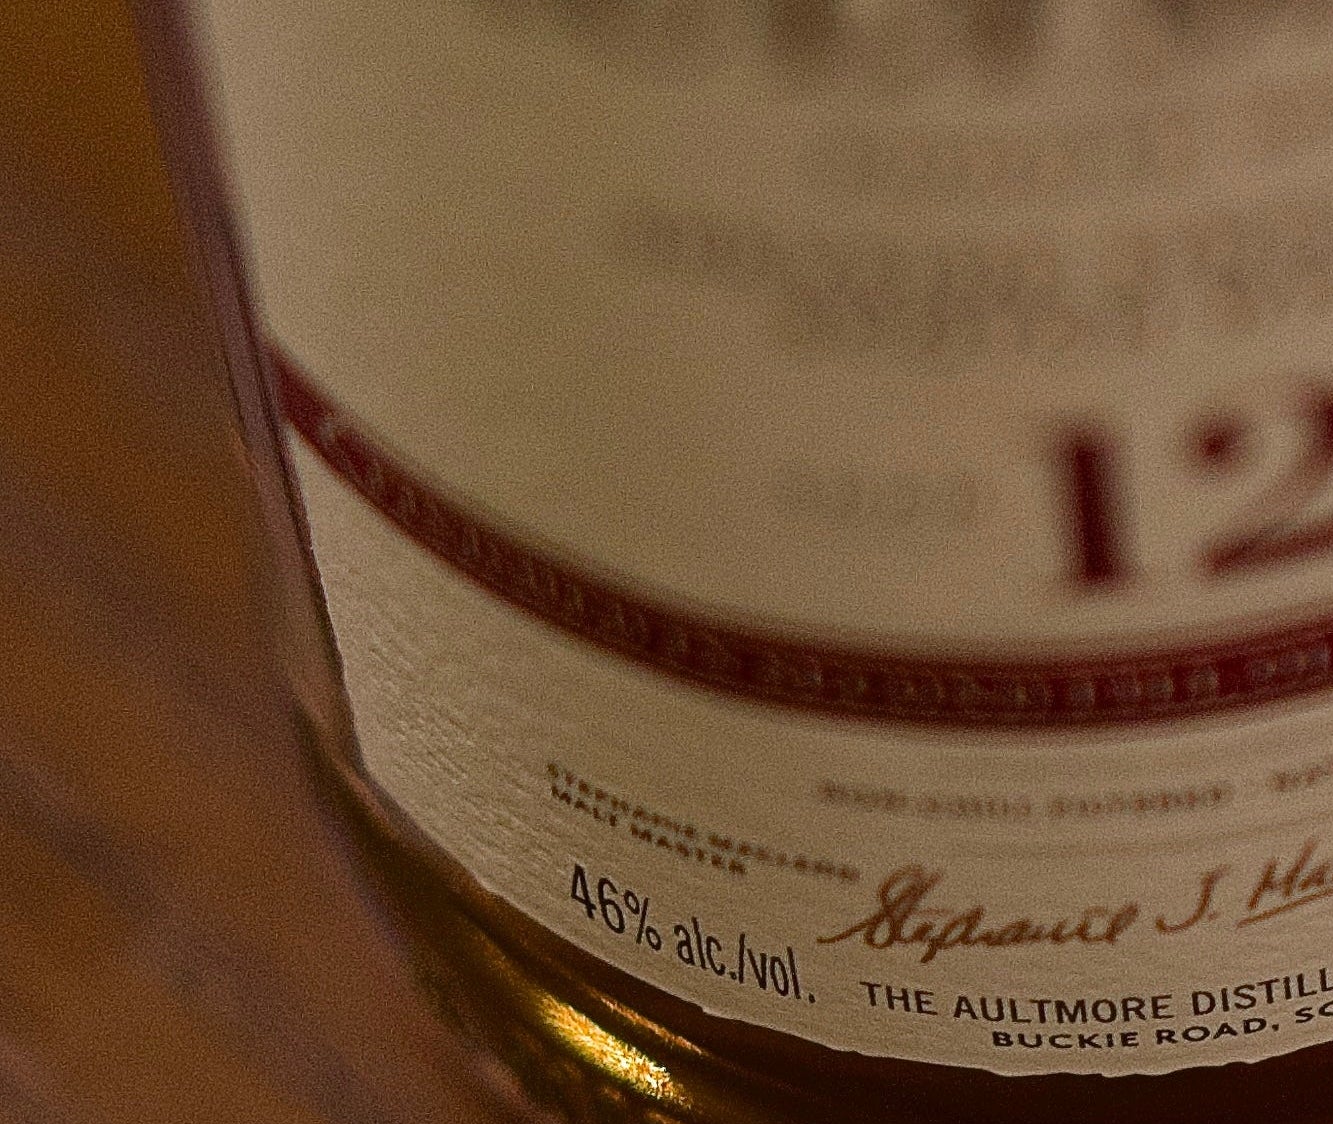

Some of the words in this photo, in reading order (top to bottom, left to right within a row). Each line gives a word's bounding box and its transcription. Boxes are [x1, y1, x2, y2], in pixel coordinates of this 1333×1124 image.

[629, 822, 749, 876] MASTER
[570, 863, 663, 952] 46%
[673, 915, 817, 1005] alc./vol.
[858, 980, 939, 1017] THE
[952, 993, 1175, 1026] AULTMORE
[992, 1030, 1140, 1050] BUCKIE
[1155, 1016, 1281, 1046] ROAD,
